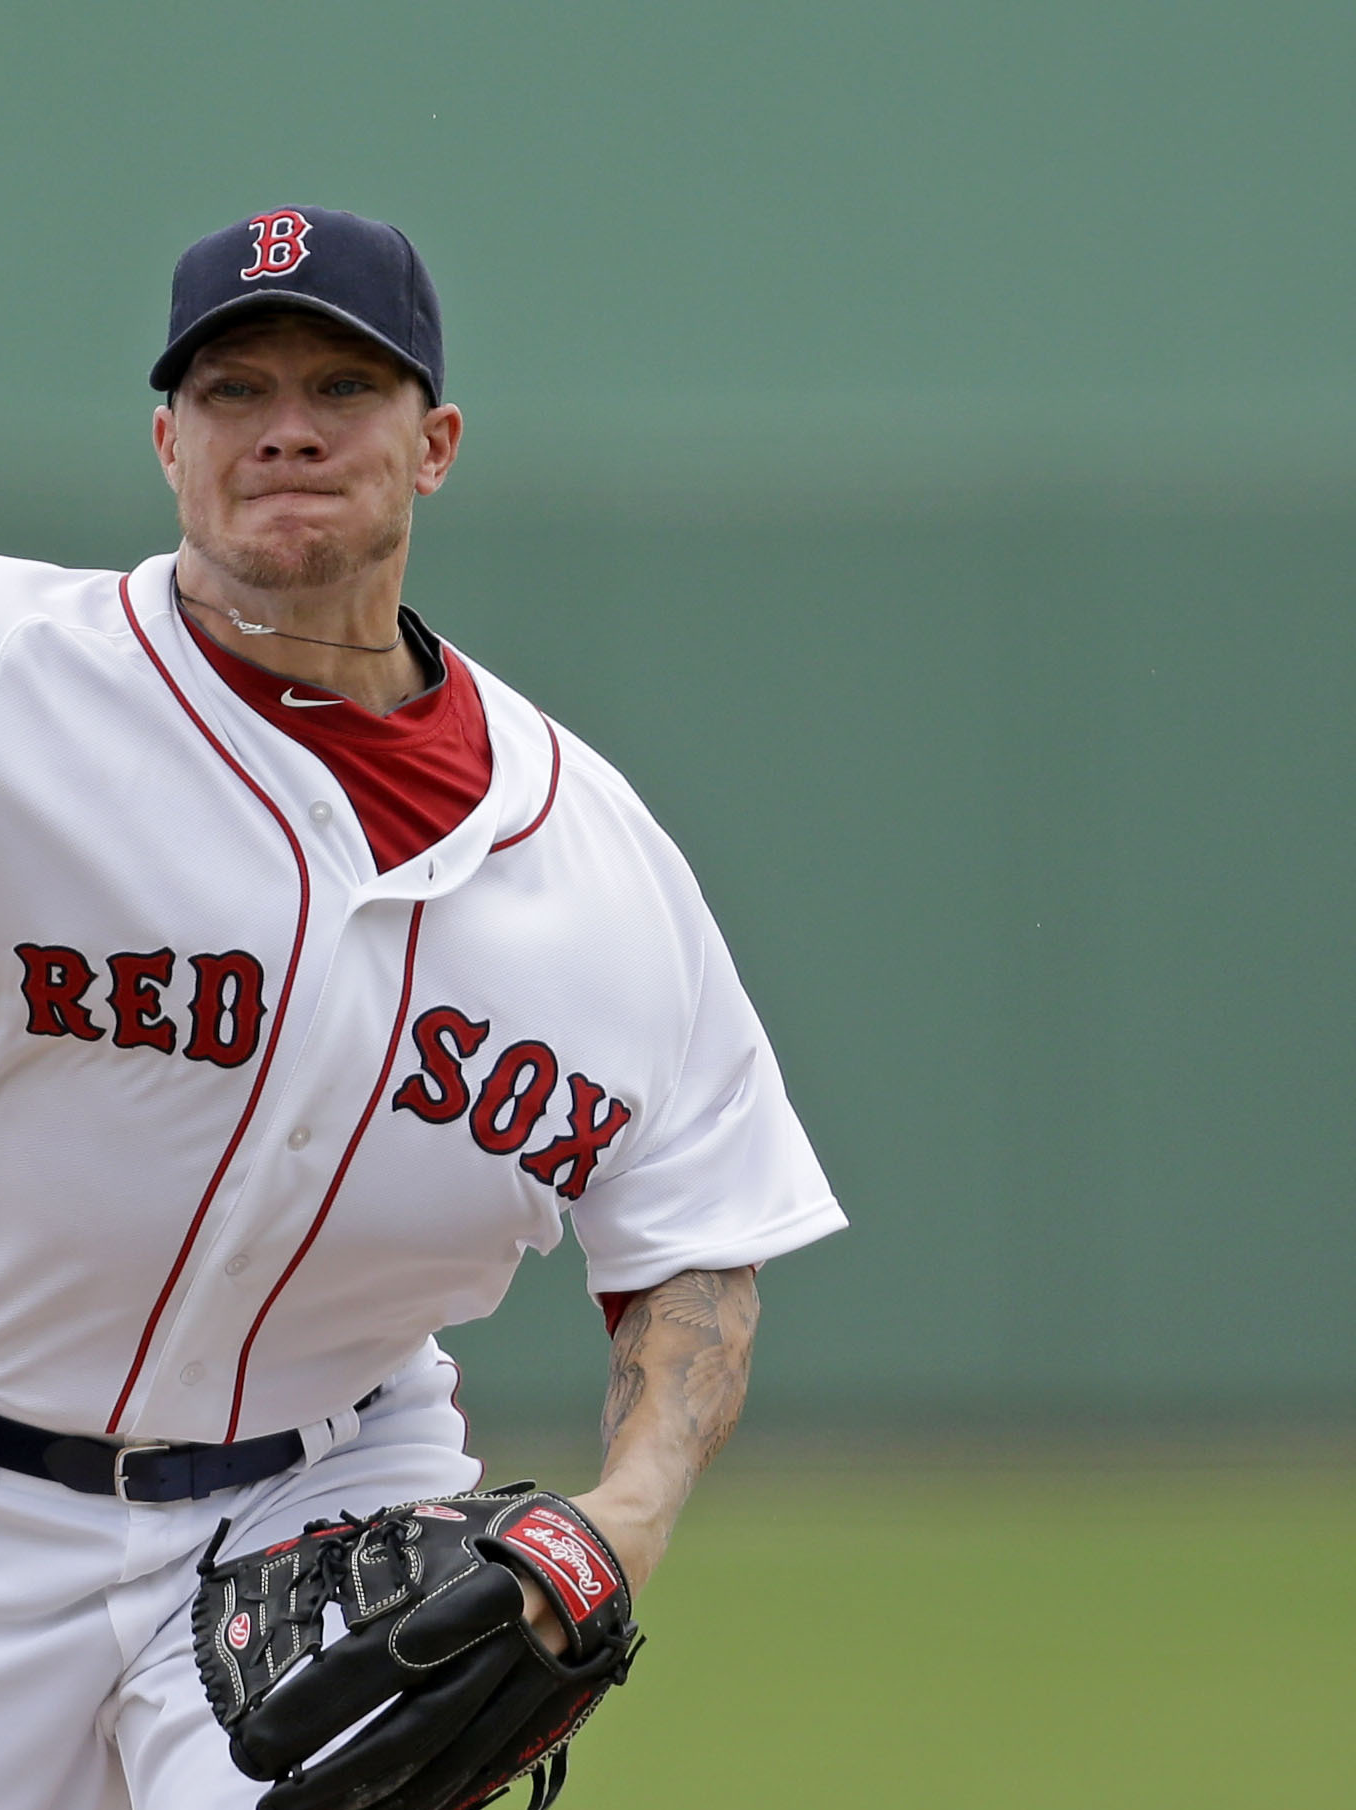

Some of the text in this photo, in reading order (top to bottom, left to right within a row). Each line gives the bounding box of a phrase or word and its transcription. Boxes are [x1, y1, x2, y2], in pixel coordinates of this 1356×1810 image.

[241, 209, 313, 281] B
[14, 942, 631, 1200] RED SOX
[522, 1527, 602, 1595] Rawlings
